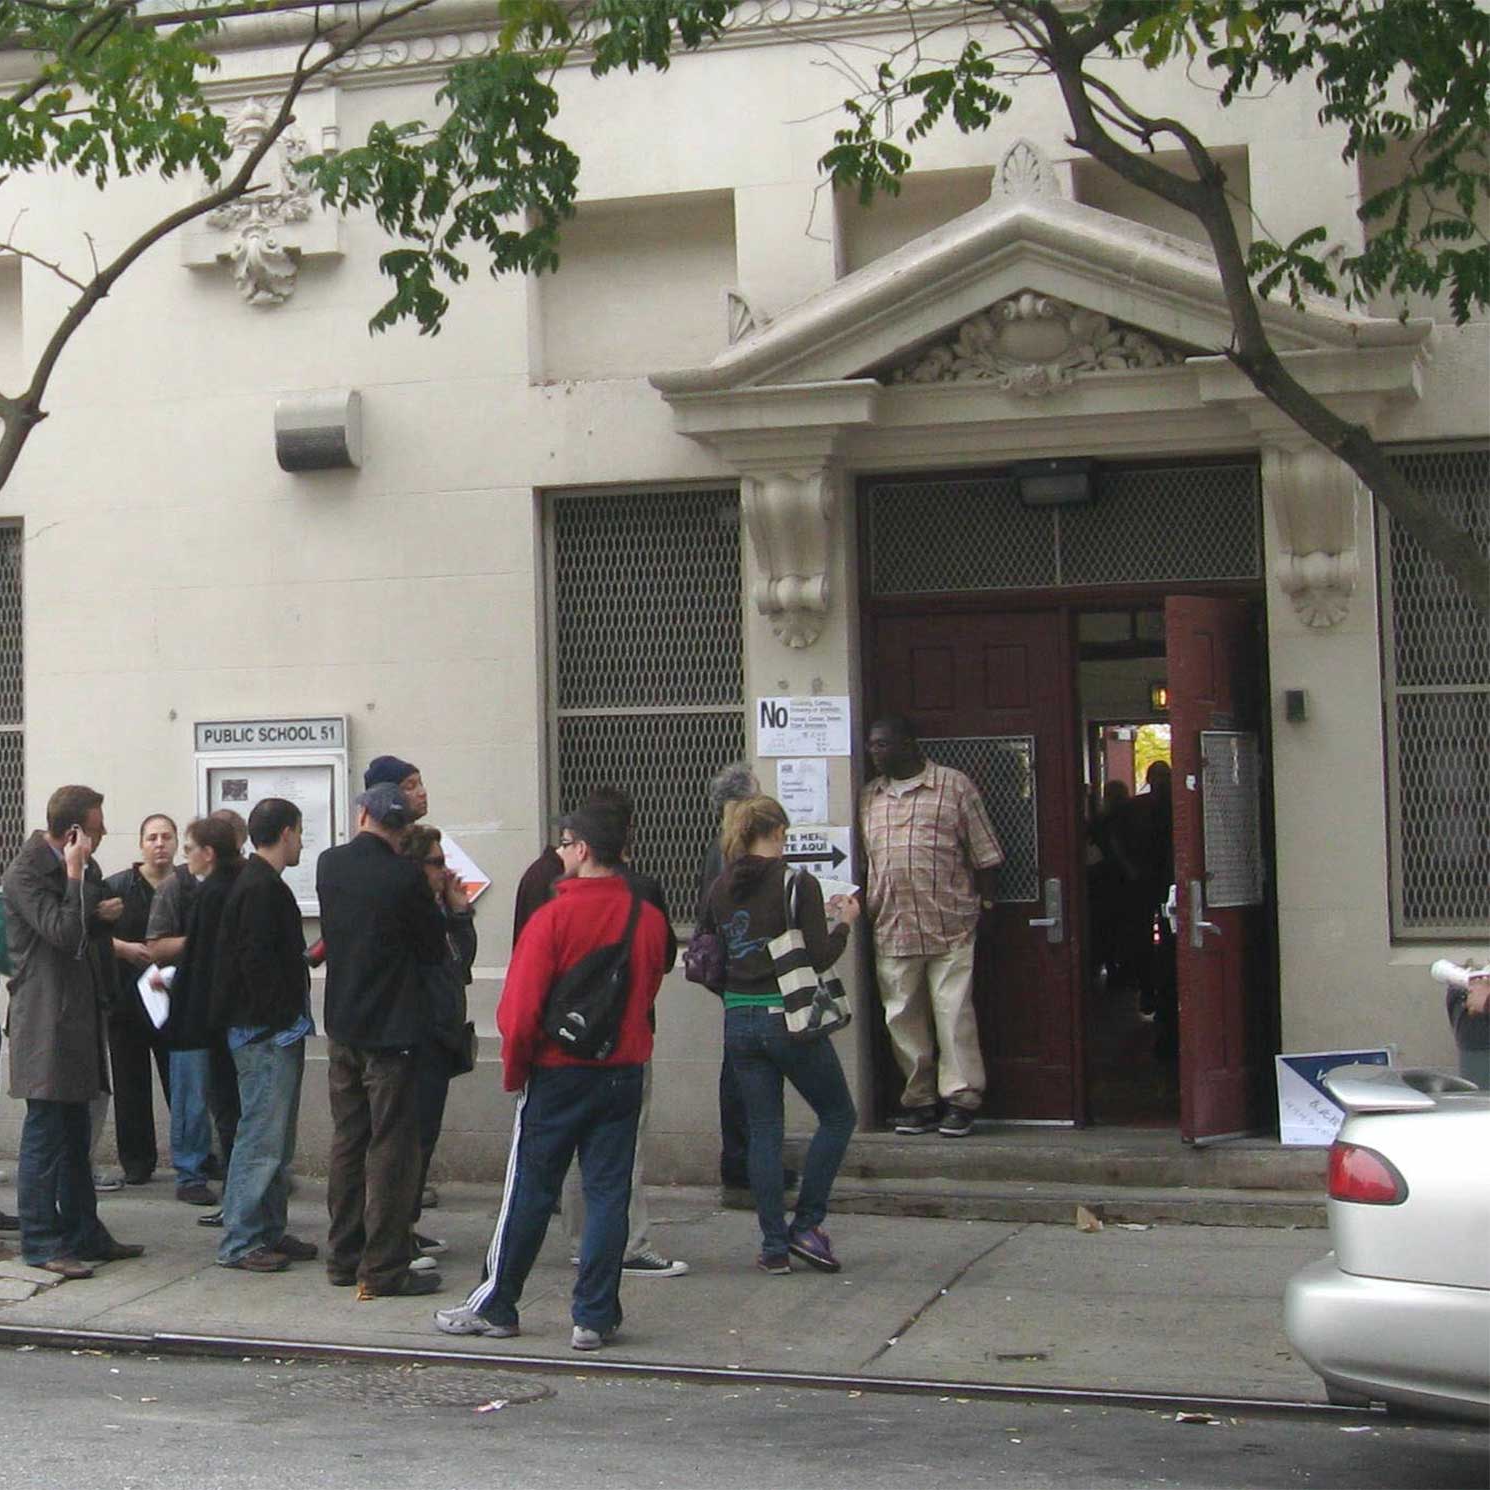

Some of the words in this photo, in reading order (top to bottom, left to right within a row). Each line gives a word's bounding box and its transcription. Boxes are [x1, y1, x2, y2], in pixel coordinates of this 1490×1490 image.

[760, 701, 788, 728] No
[204, 727, 255, 743] PUBLIC
[258, 726, 317, 742] SCHOOL
[320, 726, 335, 740] 51
